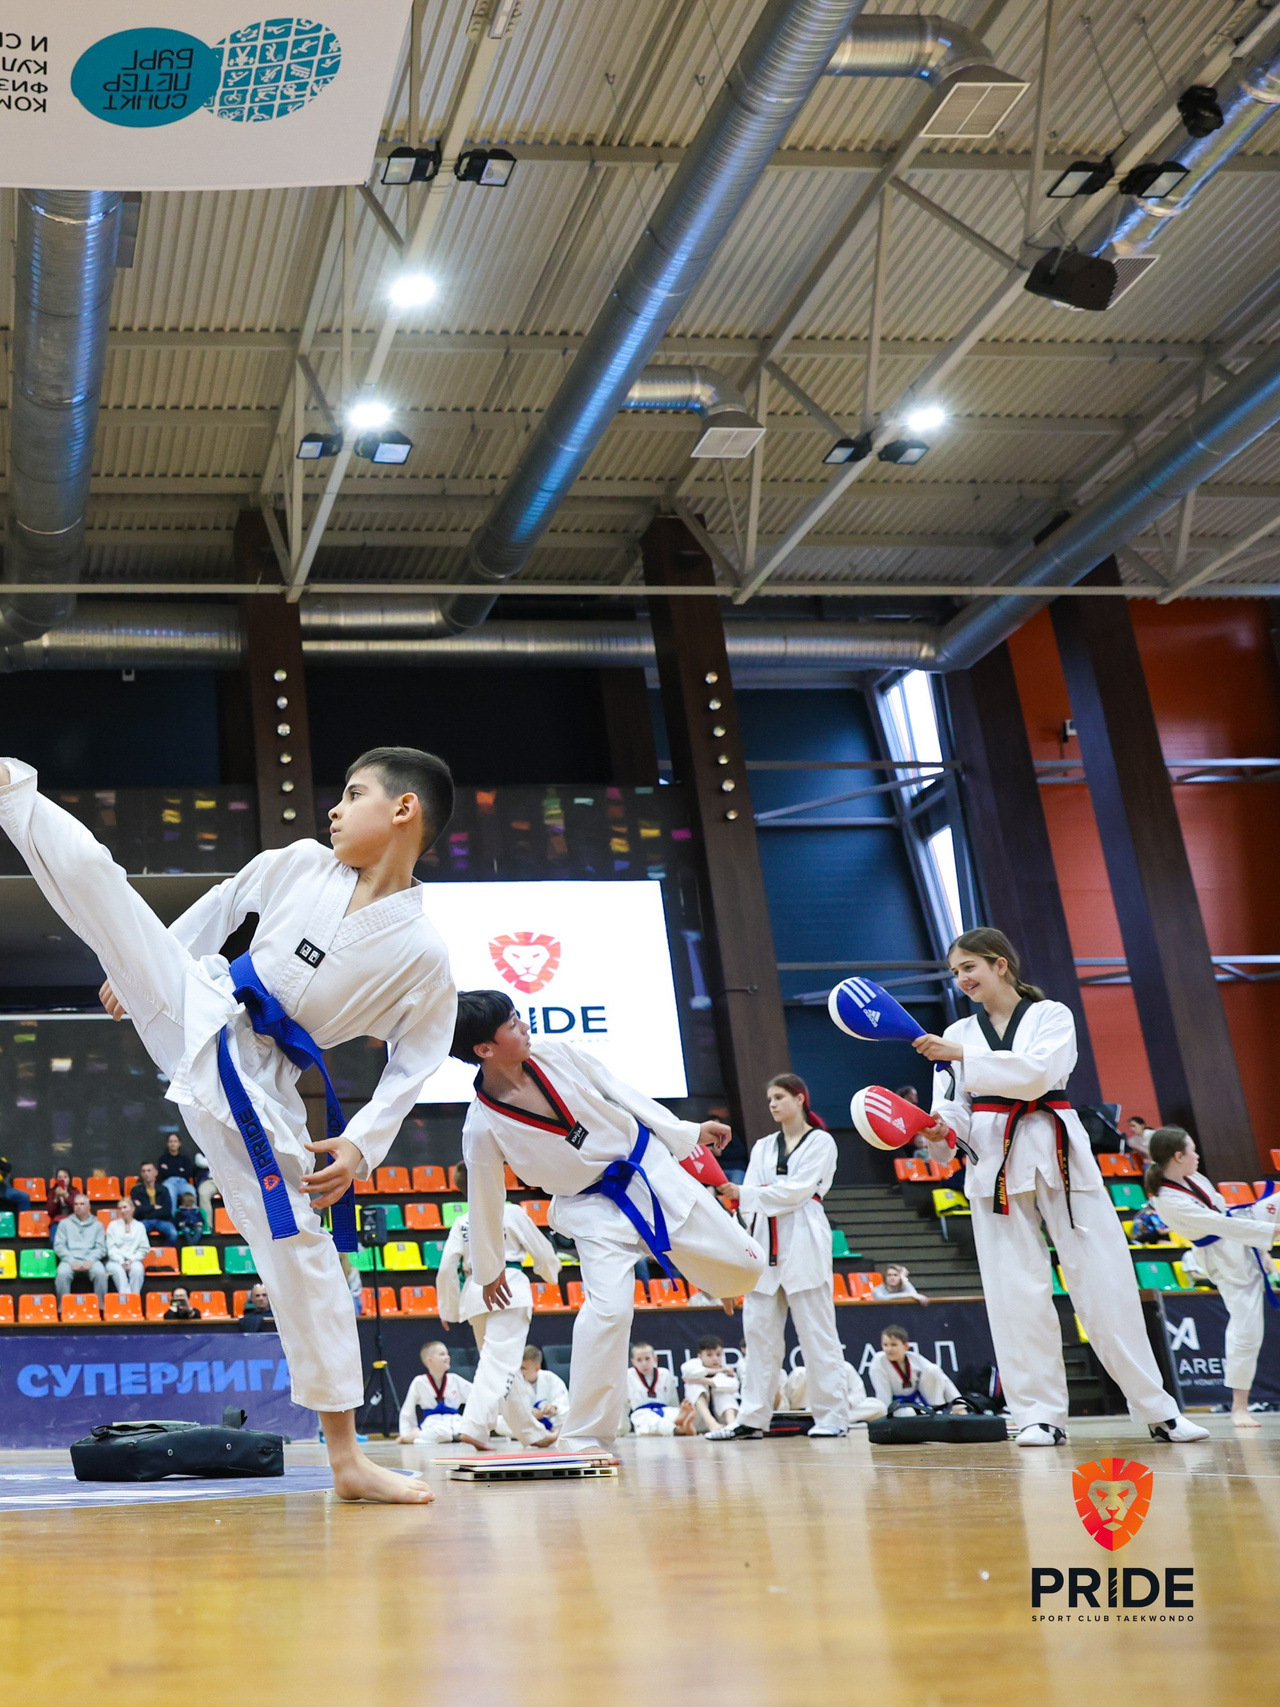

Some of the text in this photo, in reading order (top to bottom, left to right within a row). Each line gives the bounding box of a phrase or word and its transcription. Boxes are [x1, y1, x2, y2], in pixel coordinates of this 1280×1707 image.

[31, 35, 48, 52] И
[121, 48, 194, 70] БУРГ
[102, 72, 191, 92] ПЕТЕР
[517, 1006, 608, 1034] IDE
[239, 1107, 272, 1169] PRIDE
[16, 1359, 292, 1398] СУПЕРЛИГА
